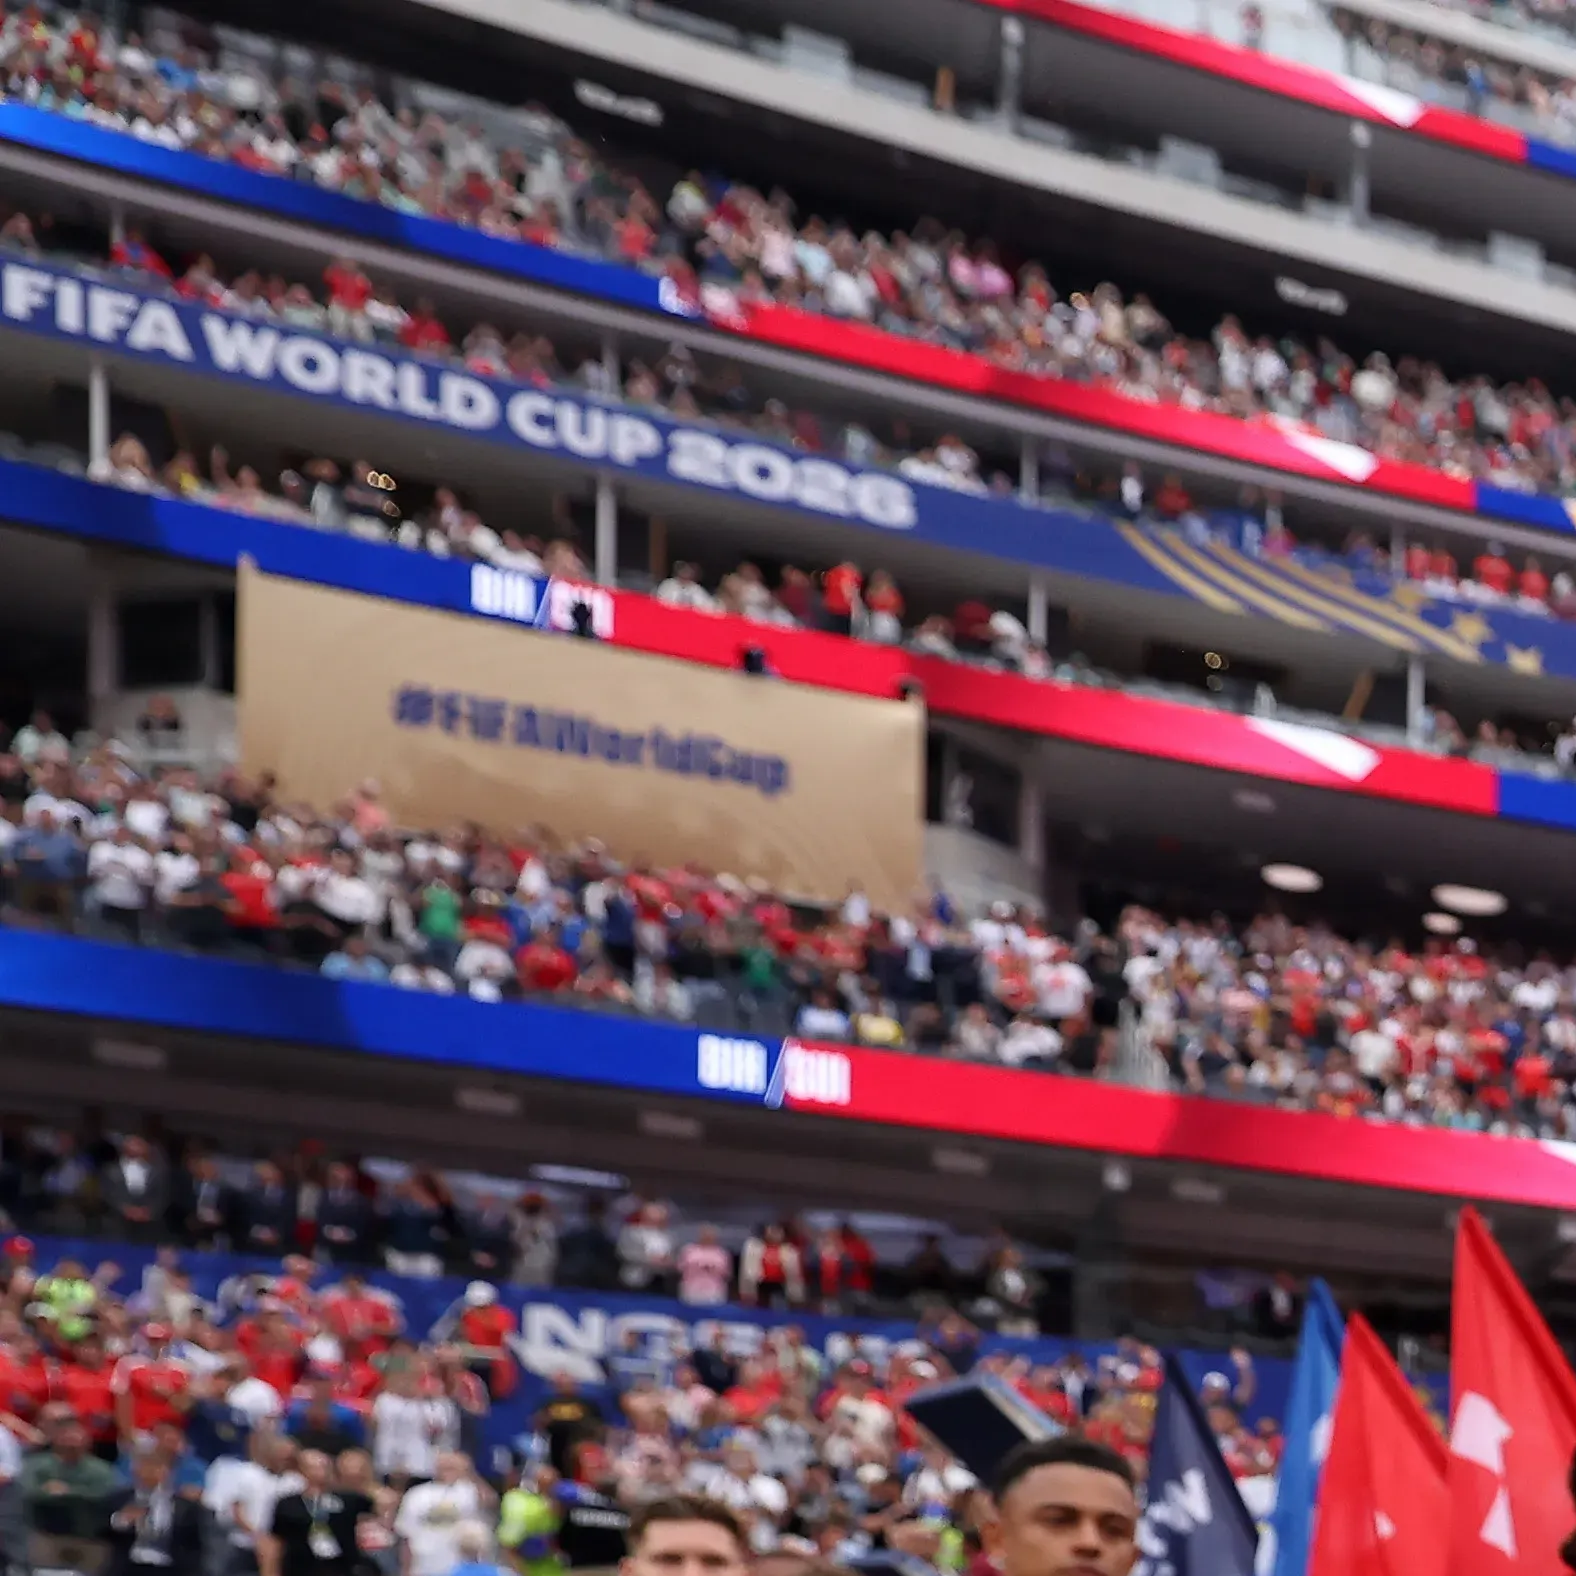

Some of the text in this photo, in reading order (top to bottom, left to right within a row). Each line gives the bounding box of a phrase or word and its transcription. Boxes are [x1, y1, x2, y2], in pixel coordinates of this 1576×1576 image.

[2, 263, 918, 530] FIFA WORLD CUP 2026
